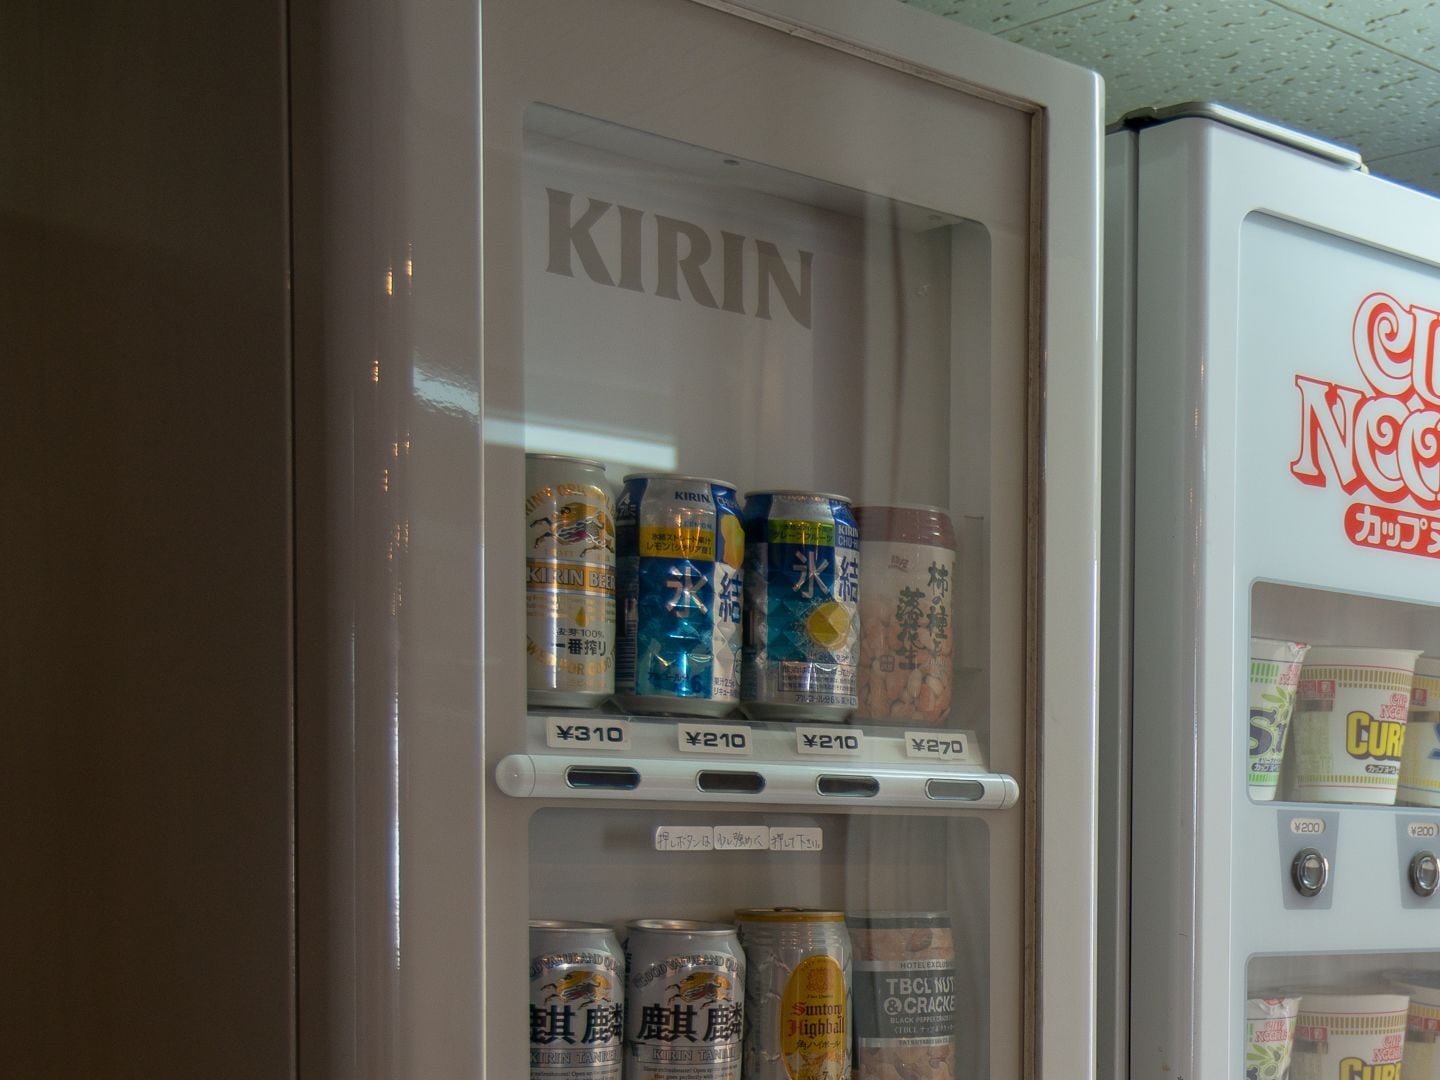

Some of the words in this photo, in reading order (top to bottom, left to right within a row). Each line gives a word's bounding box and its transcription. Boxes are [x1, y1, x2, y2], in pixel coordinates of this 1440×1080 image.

[545, 187, 813, 331] KIRIN
[675, 491, 711, 503] KIRIN
[527, 566, 584, 587] KIRIN
[590, 572, 616, 590] BEER
[552, 637, 607, 657] 一番搾り
[556, 725, 625, 744] ¥310
[686, 731, 747, 748] ¥210
[803, 734, 859, 750] ¥210
[912, 737, 964, 756] ¥270
[1294, 821, 1321, 834] ¥200
[1411, 825, 1435, 837] ¥200
[886, 978, 932, 994] TBCL
[791, 1002, 842, 1020] Suntory
[637, 1003, 743, 1043] 麒麟
[787, 1019, 845, 1039] Highball
[652, 1048, 693, 1061] KIRIN
